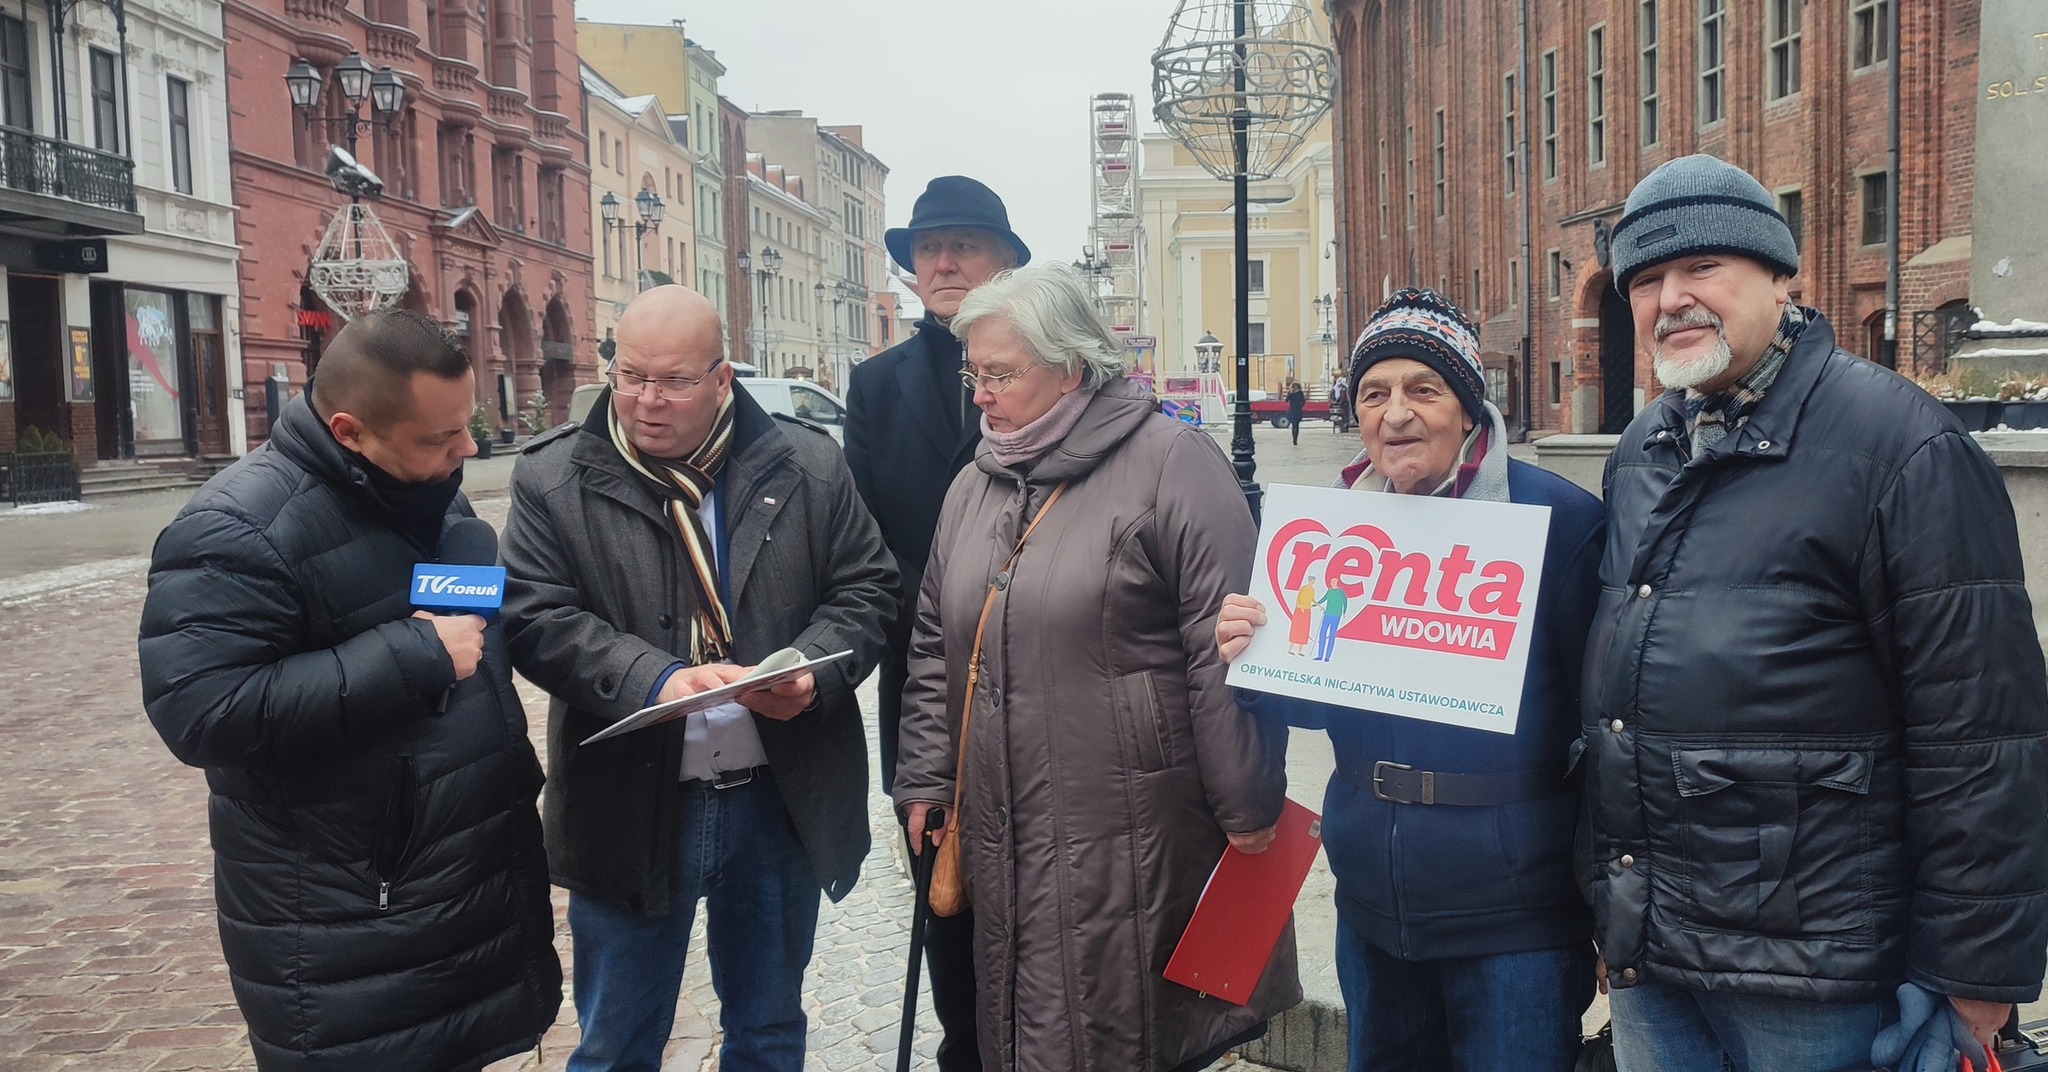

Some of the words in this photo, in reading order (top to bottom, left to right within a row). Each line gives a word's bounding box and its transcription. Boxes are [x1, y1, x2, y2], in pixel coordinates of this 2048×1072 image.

[417, 575, 460, 594] TV
[446, 584, 498, 596] TORUŃ
[1284, 540, 1526, 617] renta
[1380, 614, 1497, 652] WDOWIA
[1240, 663, 1322, 686] OBYWATELSKA
[1324, 677, 1395, 698] INICJATYWA
[1398, 690, 1504, 716] USTAWODAWCZA
